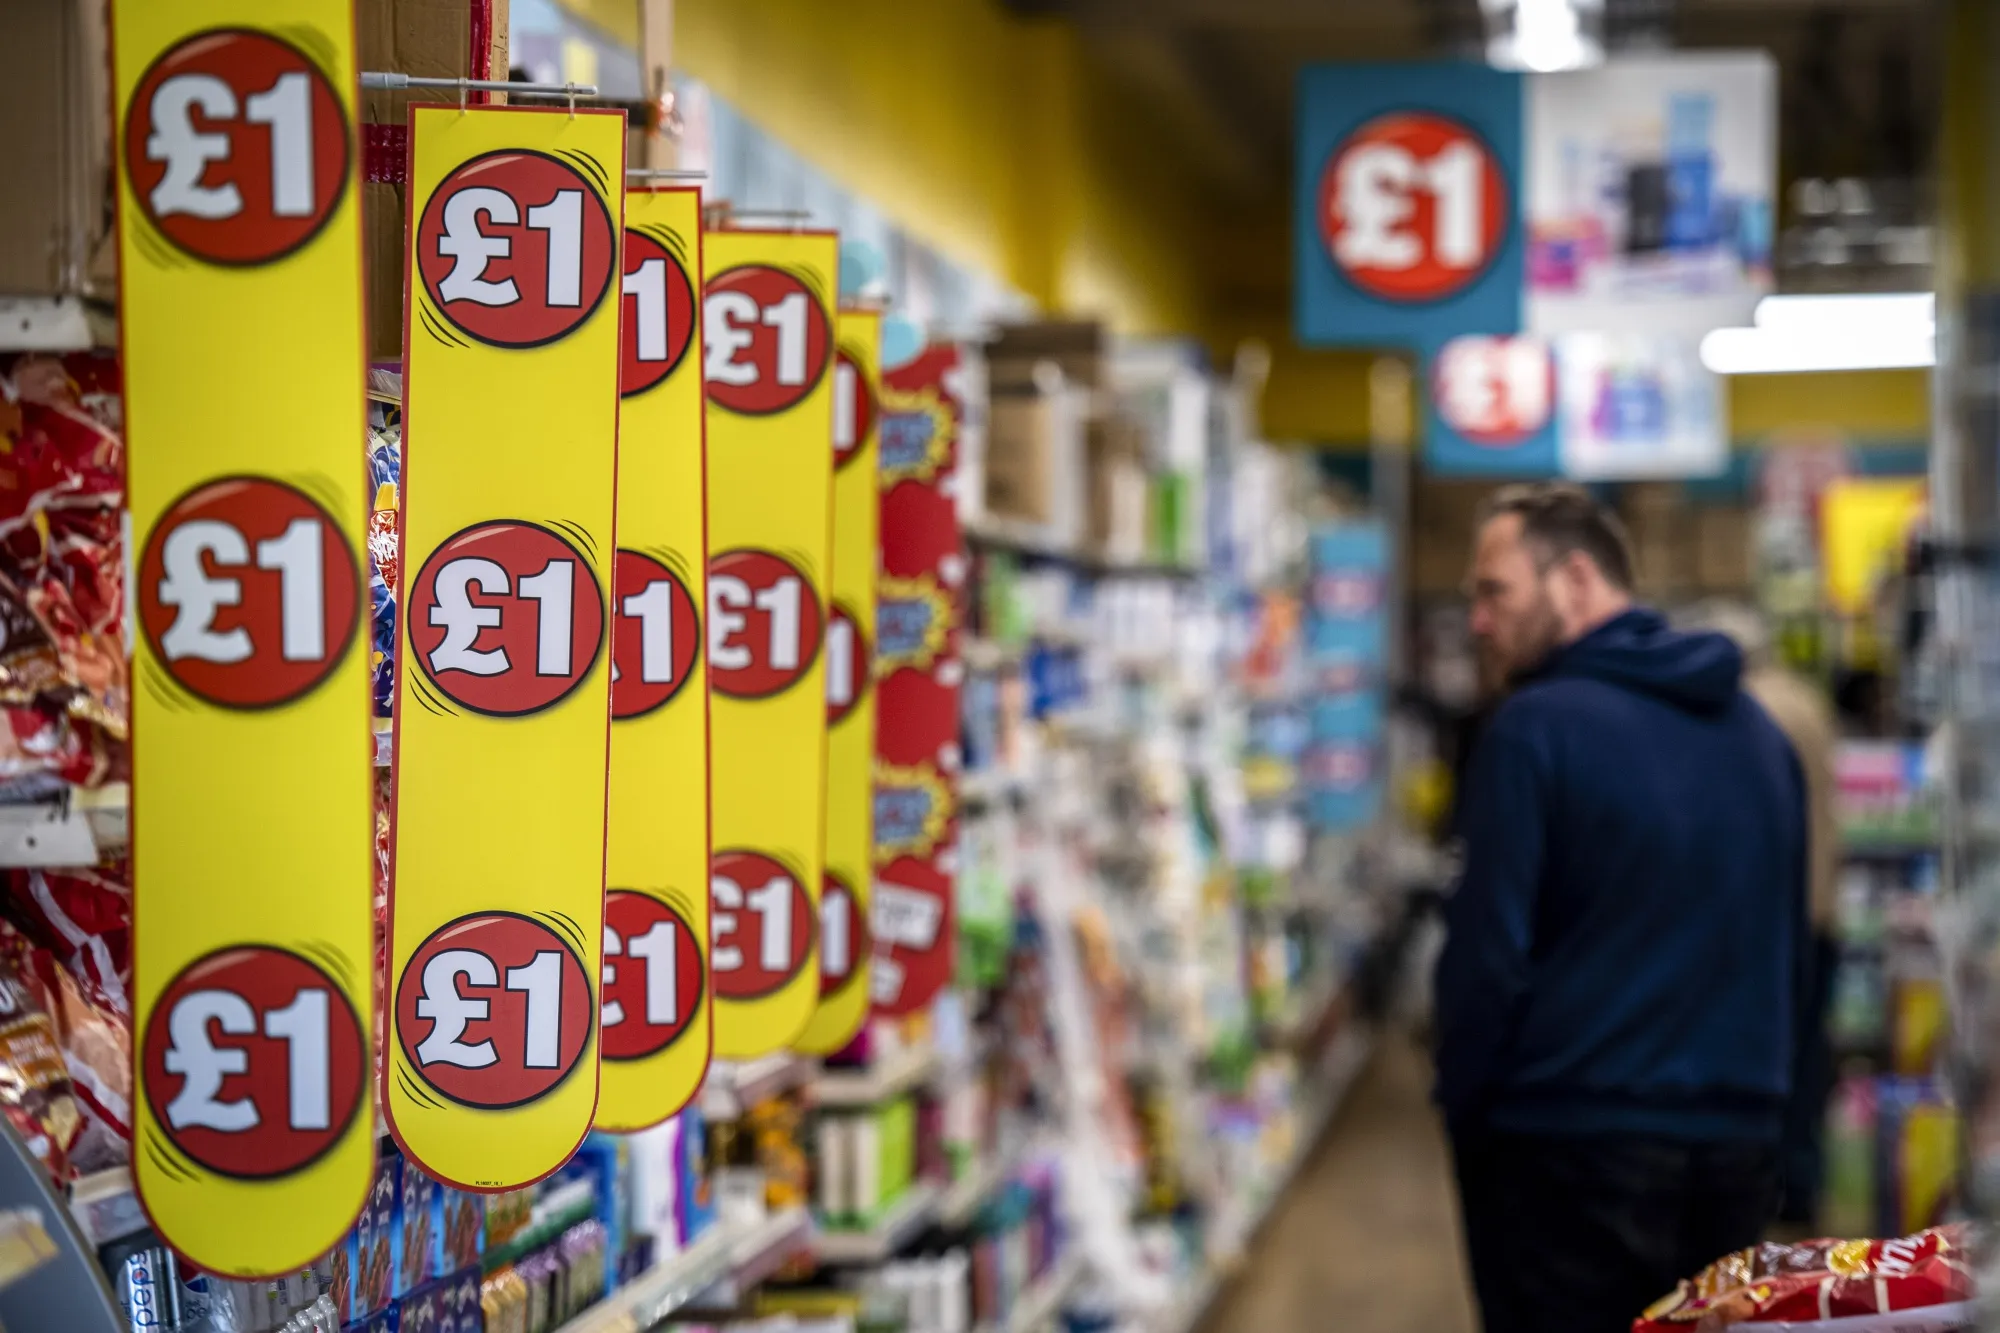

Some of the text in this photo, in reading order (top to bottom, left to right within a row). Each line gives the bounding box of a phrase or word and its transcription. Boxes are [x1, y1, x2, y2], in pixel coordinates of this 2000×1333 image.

[147, 72, 315, 219] £1
[437, 187, 584, 307] £1
[1331, 140, 1486, 273] £1
[623, 258, 668, 362] 1
[705, 290, 809, 386] £1
[158, 517, 326, 664] £1
[428, 556, 575, 677] £1
[613, 579, 673, 684] 1
[708, 574, 801, 671] £1
[164, 988, 331, 1132] £1
[415, 948, 564, 1070] £1
[129, 1250, 161, 1327] peps
